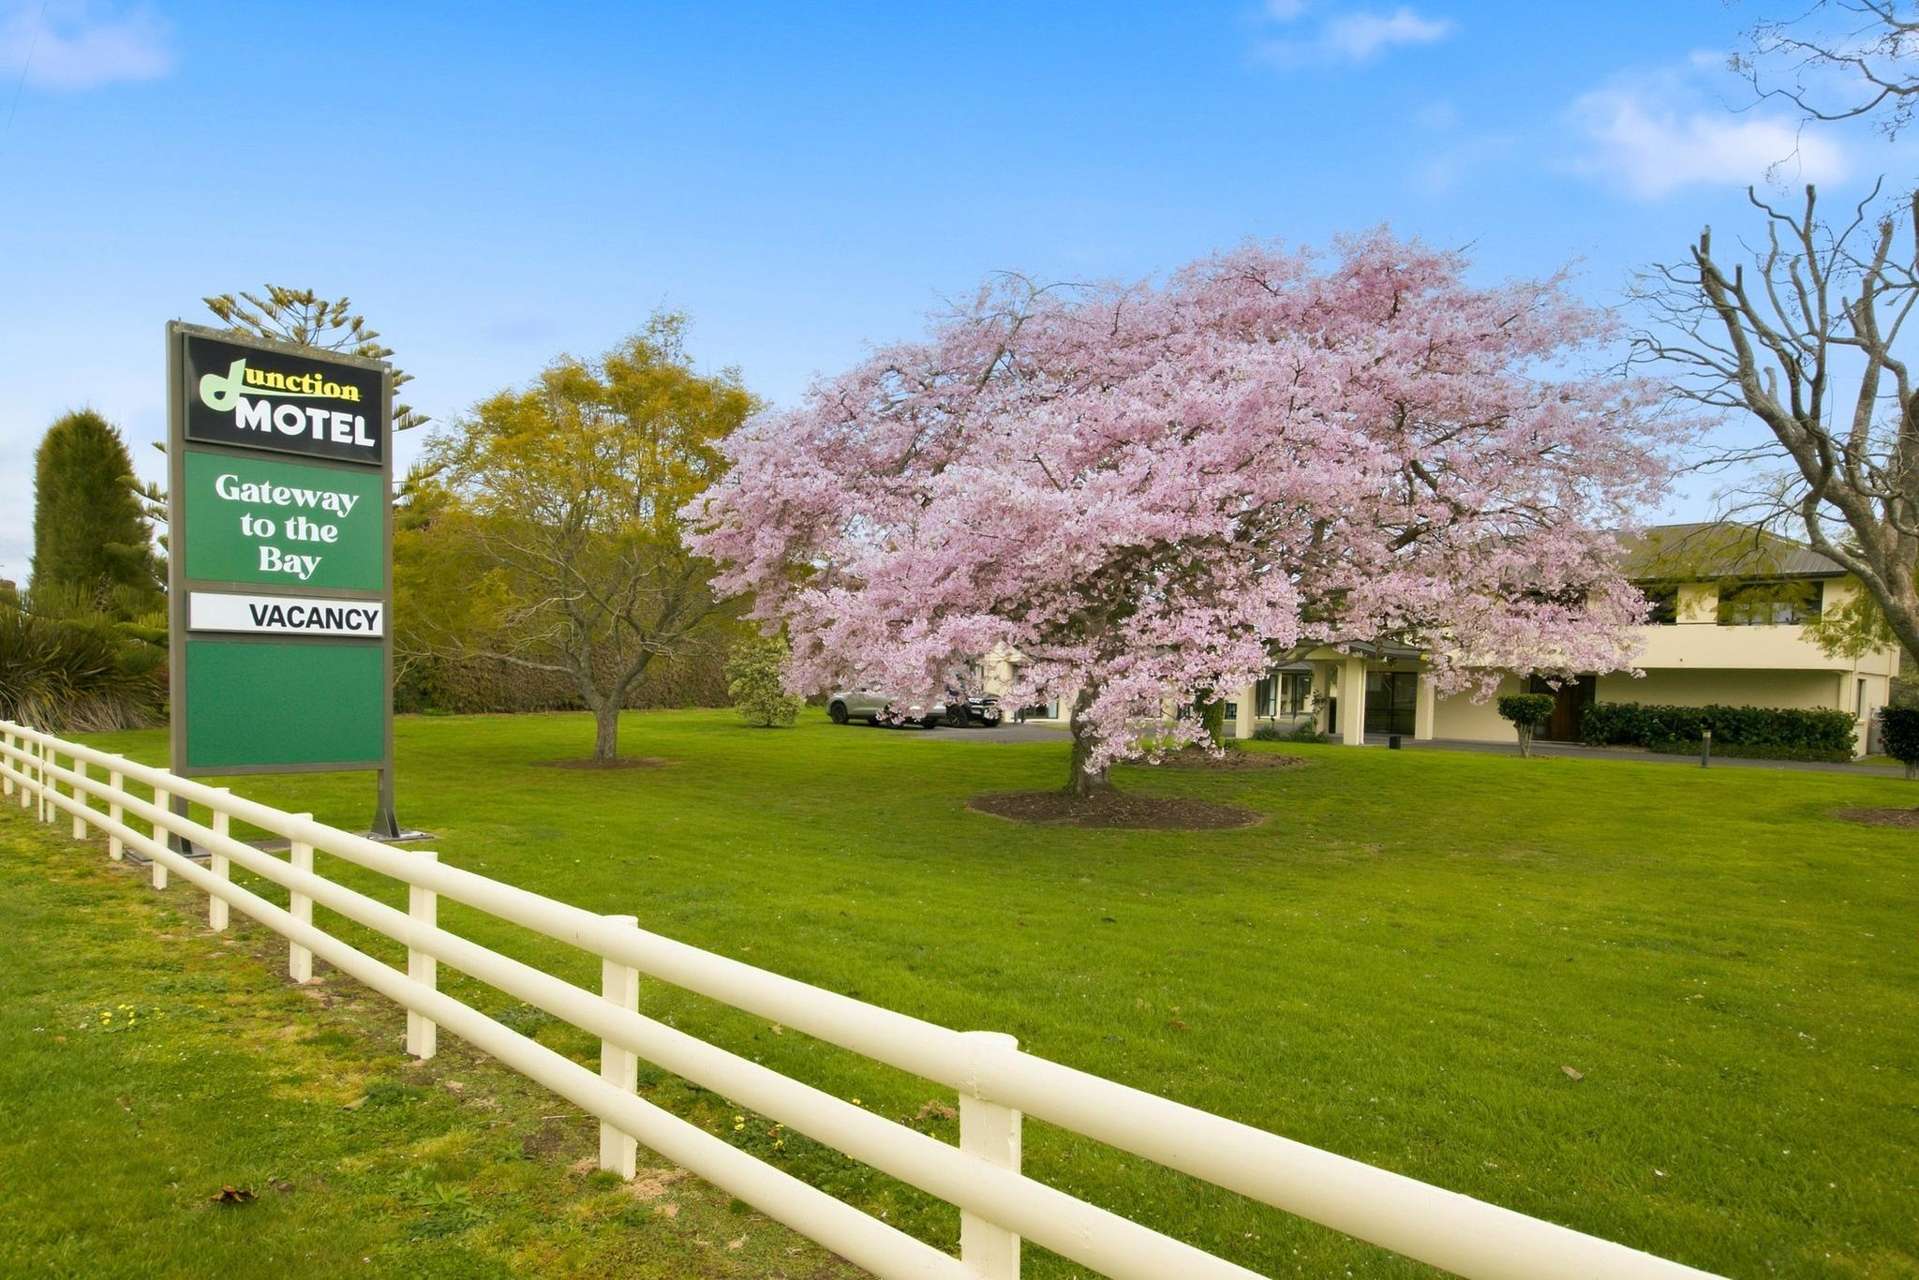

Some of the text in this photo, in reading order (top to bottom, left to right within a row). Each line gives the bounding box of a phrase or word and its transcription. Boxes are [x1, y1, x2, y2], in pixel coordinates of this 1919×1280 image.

[235, 396, 376, 447] MOTEL
[215, 474, 359, 518] Gateway
[240, 513, 339, 543] to the
[259, 546, 322, 580] Bay
[249, 603, 379, 631] VACANCY
